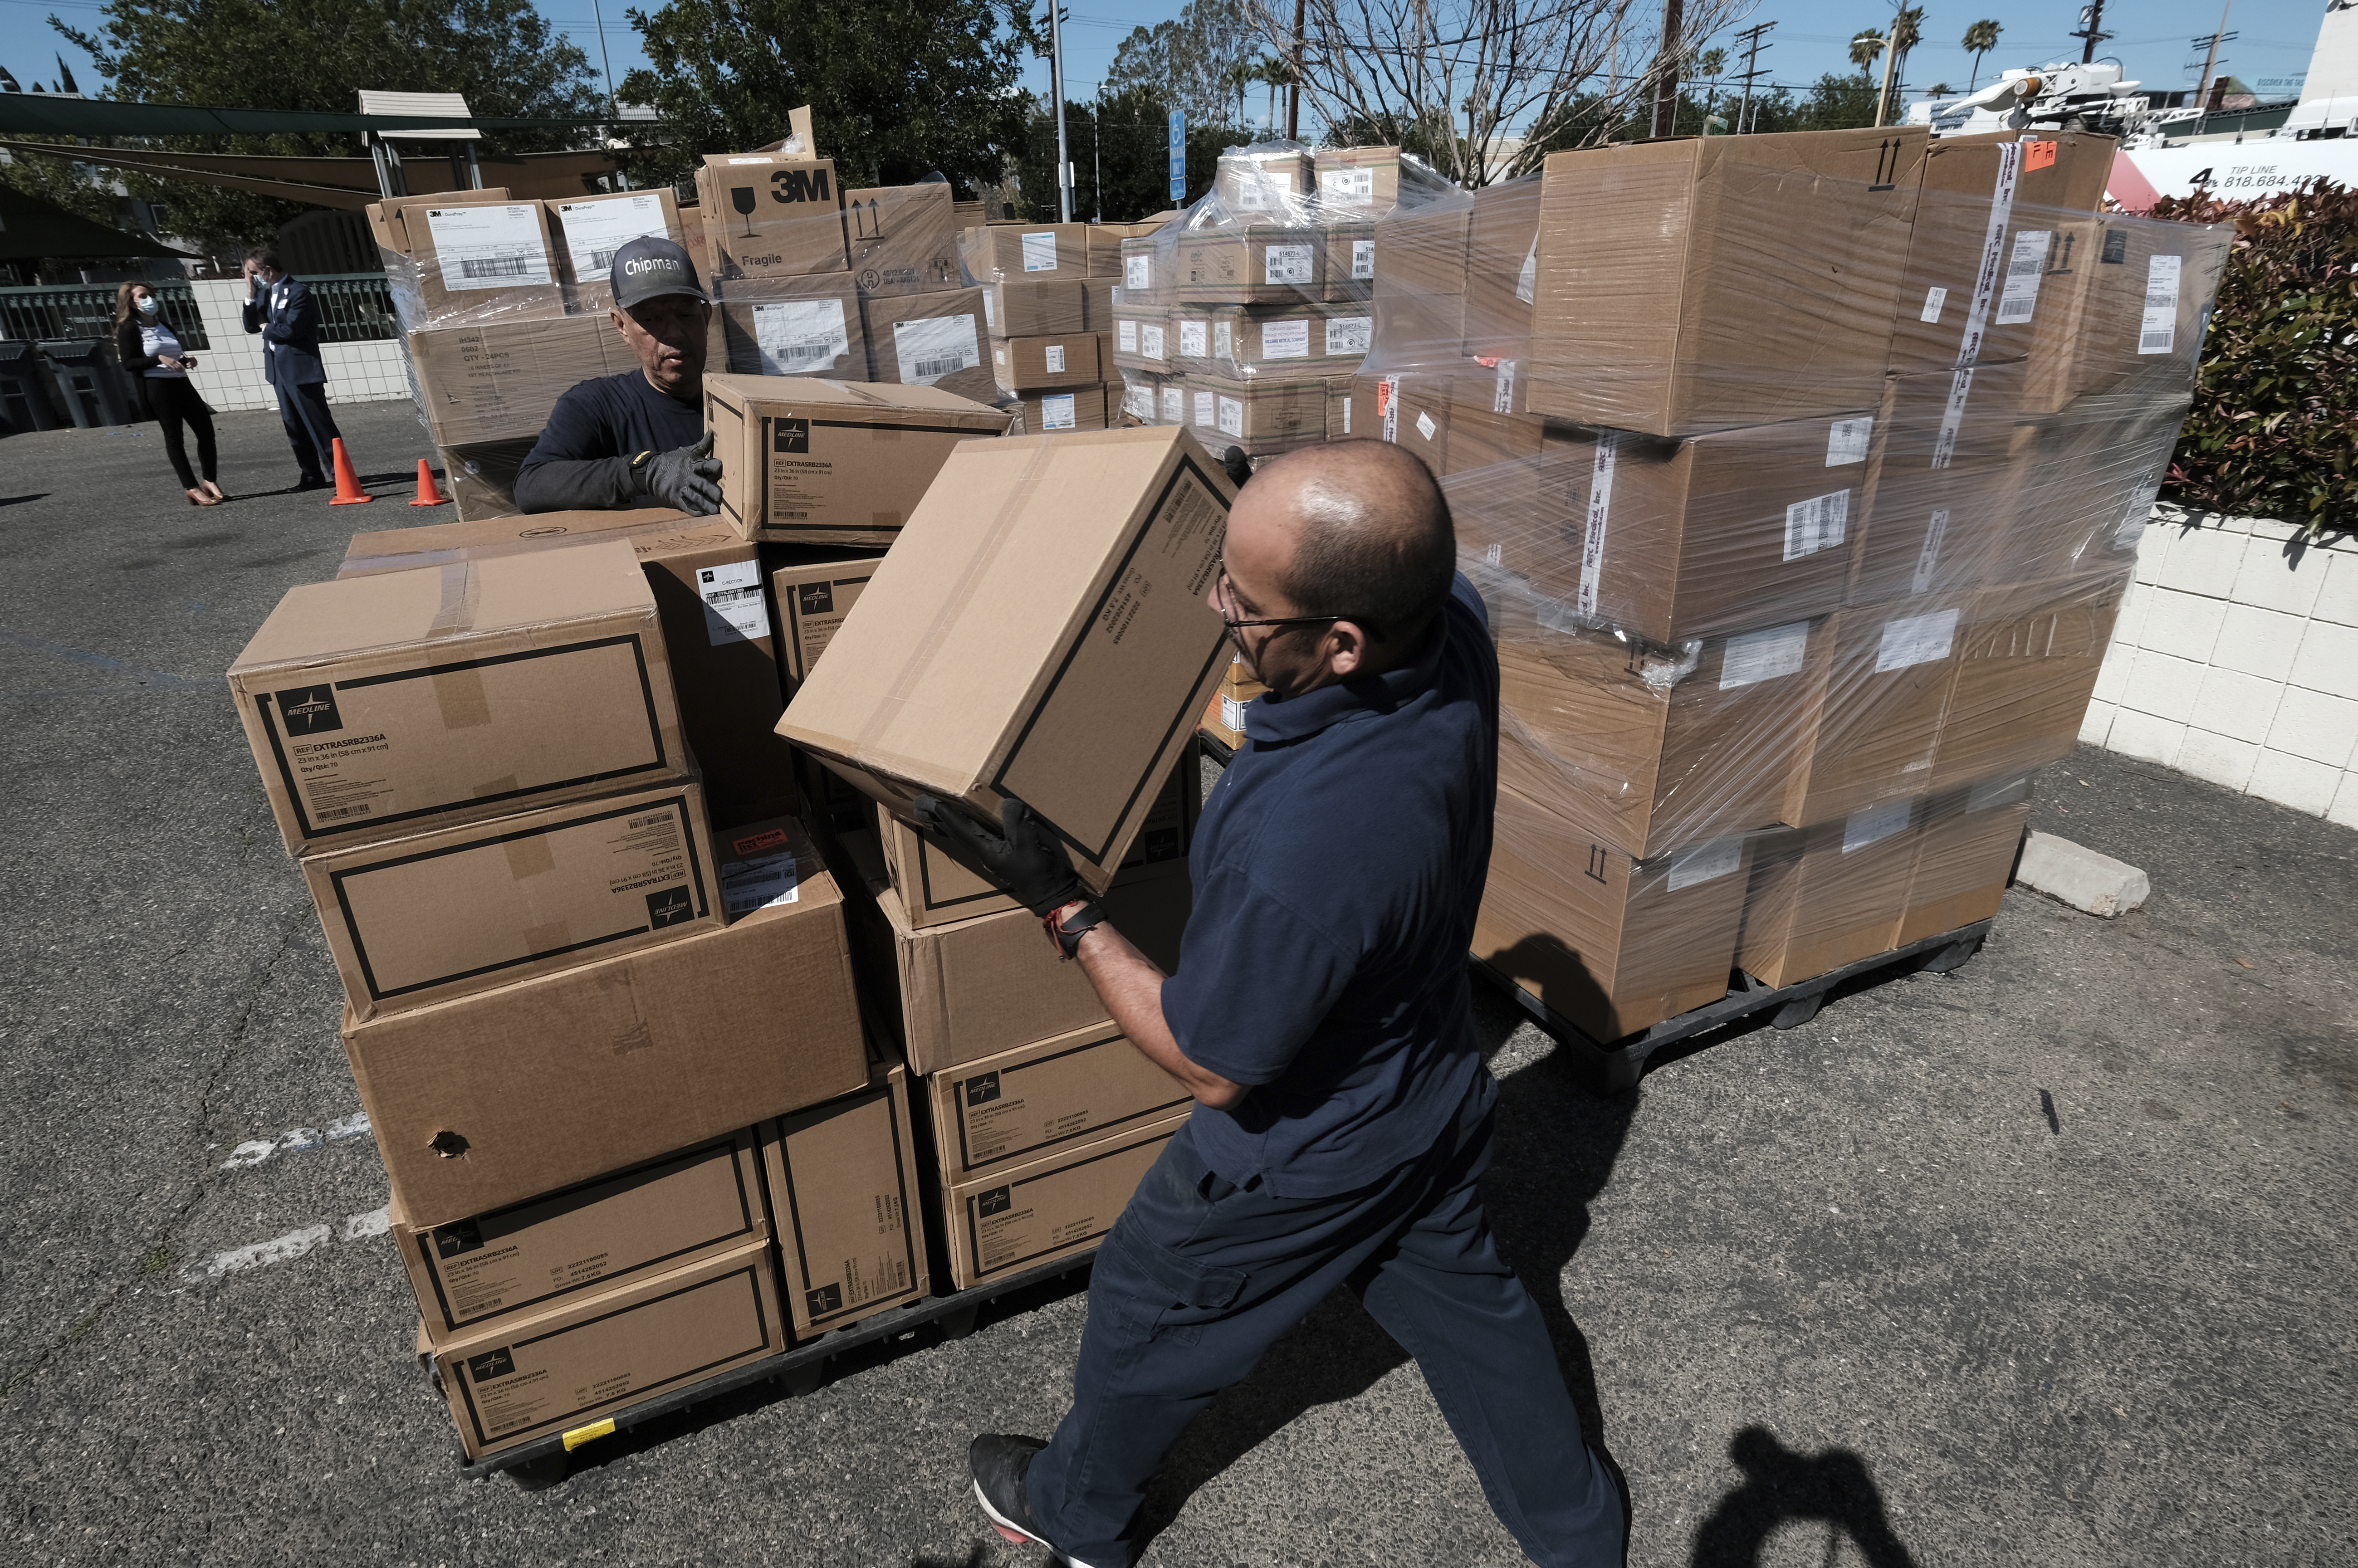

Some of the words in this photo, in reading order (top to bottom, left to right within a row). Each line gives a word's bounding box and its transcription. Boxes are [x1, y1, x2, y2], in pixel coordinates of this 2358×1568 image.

[2250, 165, 2278, 174] LINE
[771, 168, 830, 204] 3M
[1994, 224, 2003, 247] ARC
[625, 256, 680, 275] Chipman
[742, 254, 782, 267] Fragile
[1982, 251, 1999, 294] Medical,
[1968, 332, 1979, 354] ARC
[1589, 509, 1600, 544] Medical,
[717, 588, 744, 596] DYNJ907209
[287, 703, 331, 716] MEDLINE
[313, 733, 386, 752] EXTRASRB2336A
[338, 750, 350, 758] (58
[300, 764, 329, 773] Qty/Qté:
[737, 831, 782, 847] packing
[739, 842, 758, 853] list
[659, 855, 682, 865] Qty/Qté:
[611, 874, 670, 894] EXTRASRB2336A
[654, 901, 687, 915] MEDLINE
[970, 1083, 996, 1094] MEDLINE
[981, 1099, 1025, 1114] EXTRASRB2336A
[1057, 1110, 1088, 1123] 22221100085
[982, 1195, 1007, 1207] MEDLINE
[992, 1208, 1033, 1225] EXTRASRB2336A
[440, 1231, 475, 1246] MEDLINE
[460, 1245, 518, 1266] EXTRASRB2336A
[567, 1252, 608, 1269] 22221100085
[569, 1261, 607, 1277] 4514262052
[475, 1357, 508, 1371] MEDLINE
[492, 1369, 547, 1389] EXTRASRB2336A
[592, 1372, 631, 1389] 22221100085
[594, 1380, 630, 1396] 4514262052
